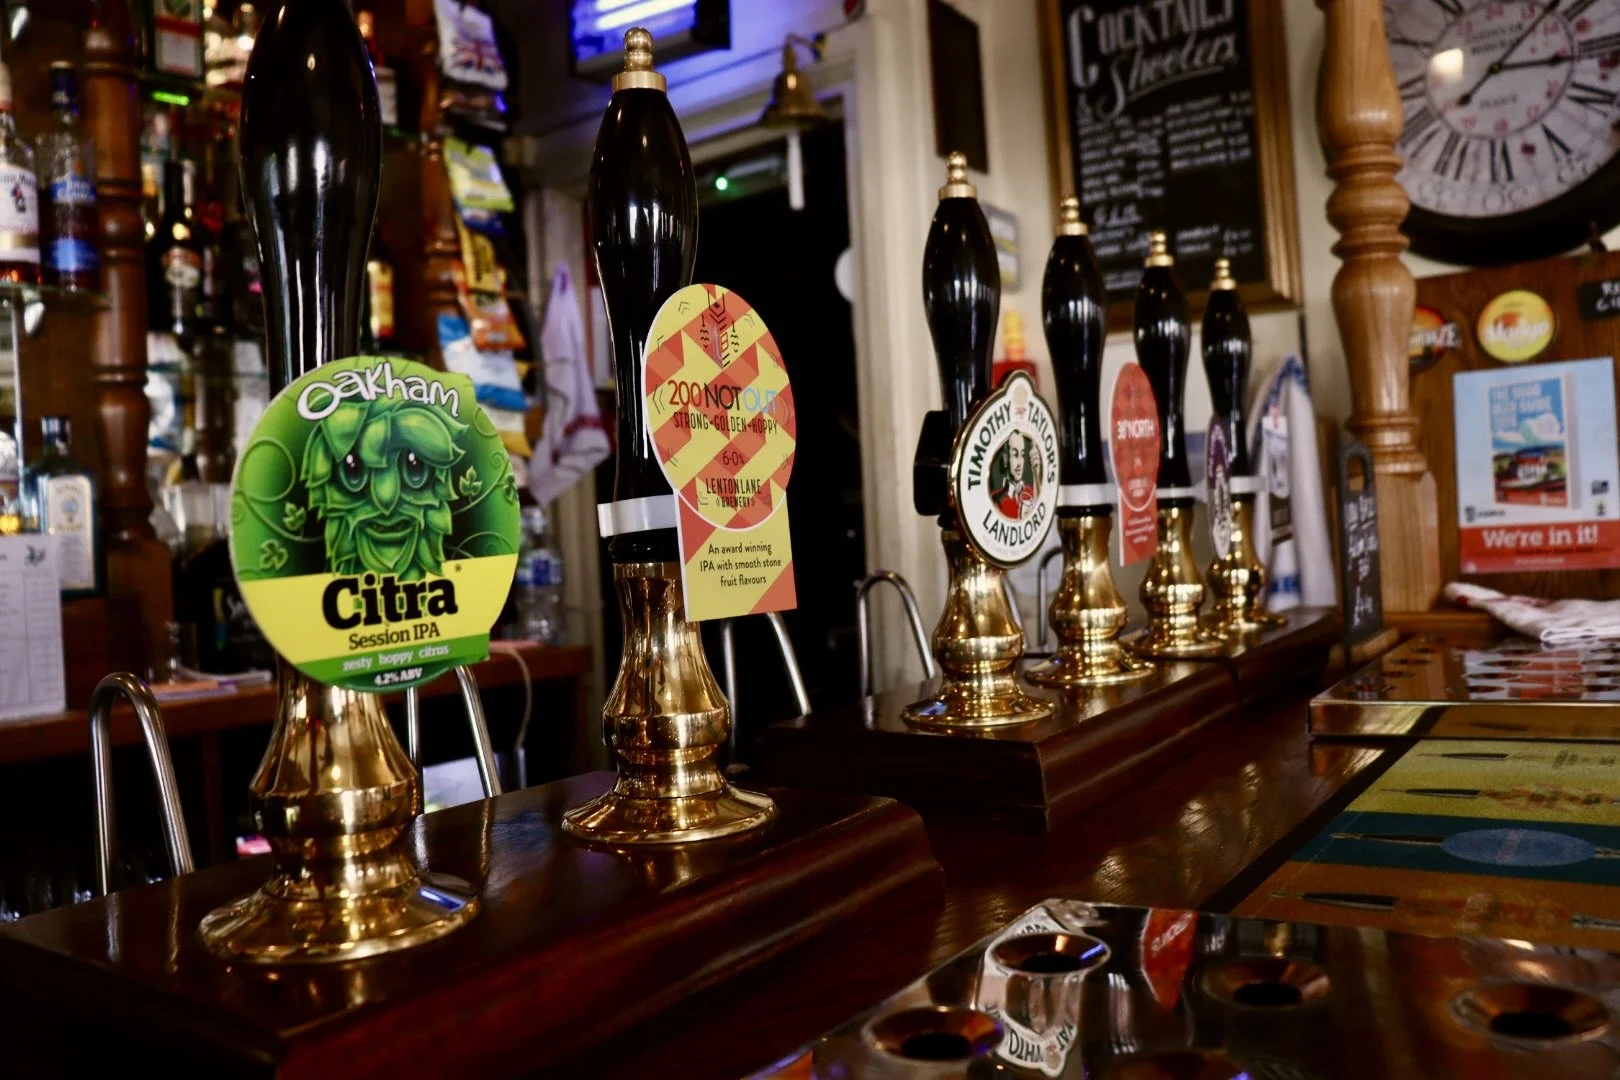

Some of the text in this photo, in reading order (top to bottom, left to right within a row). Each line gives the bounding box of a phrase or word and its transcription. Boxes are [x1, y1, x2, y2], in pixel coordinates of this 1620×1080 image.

[297, 362, 460, 421] Oakham
[667, 379, 777, 415] 200 NOT OUT
[673, 411, 777, 434] STRONG GOLDEN HOPPY
[967, 401, 1011, 491] TIMOTHY
[1028, 401, 1056, 484] TAYLOR'S
[705, 478, 761, 495] LENTON LANE
[721, 496, 750, 508] BREWERY
[982, 502, 1046, 547] LANDLORD
[1481, 523, 1599, 549] We're in it!
[708, 540, 772, 556] An award winning
[699, 557, 782, 573] IPA with smooth stone
[720, 574, 767, 588] fruit flavours
[322, 573, 458, 630] Citra
[348, 621, 440, 651] Session IPA
[342, 644, 449, 672] zesty hoppy citrus
[400, 666, 423, 682] ABV
